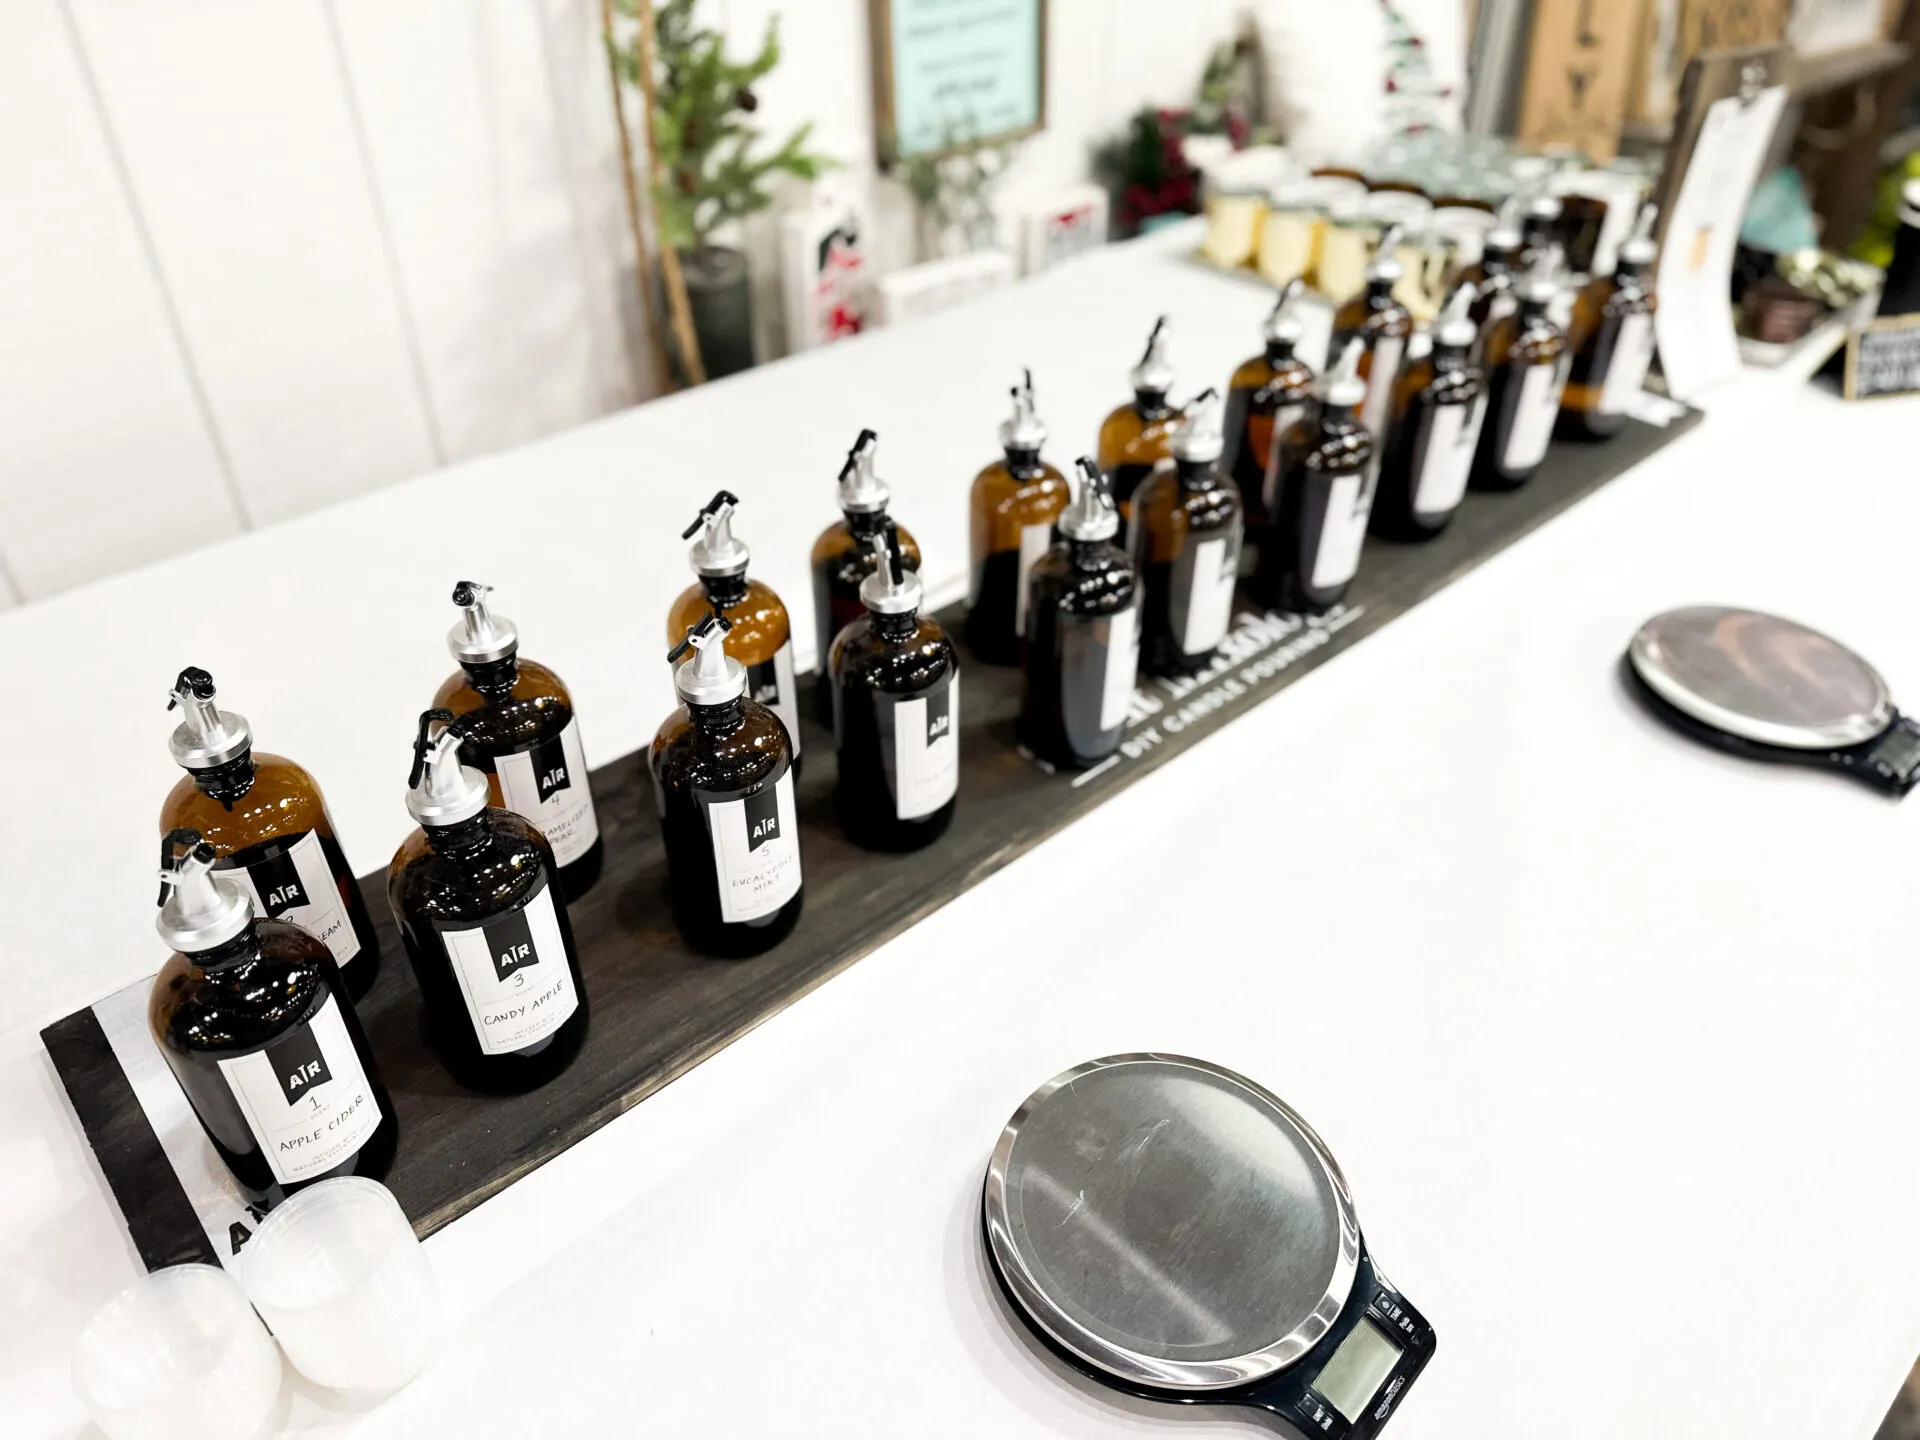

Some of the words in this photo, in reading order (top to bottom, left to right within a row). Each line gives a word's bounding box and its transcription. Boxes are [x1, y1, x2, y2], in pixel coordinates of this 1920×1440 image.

[551, 794, 560, 806] 4
[762, 845, 770, 857] 5
[753, 874, 780, 893] MINT
[318, 920, 342, 941] EAM
[514, 973, 524, 988] 3
[484, 1006, 525, 1026] CANDY
[531, 980, 563, 1010] APPLE
[309, 1096, 322, 1111] 1
[280, 1128, 323, 1152] APPLE
[328, 1094, 364, 1131] CIDER
